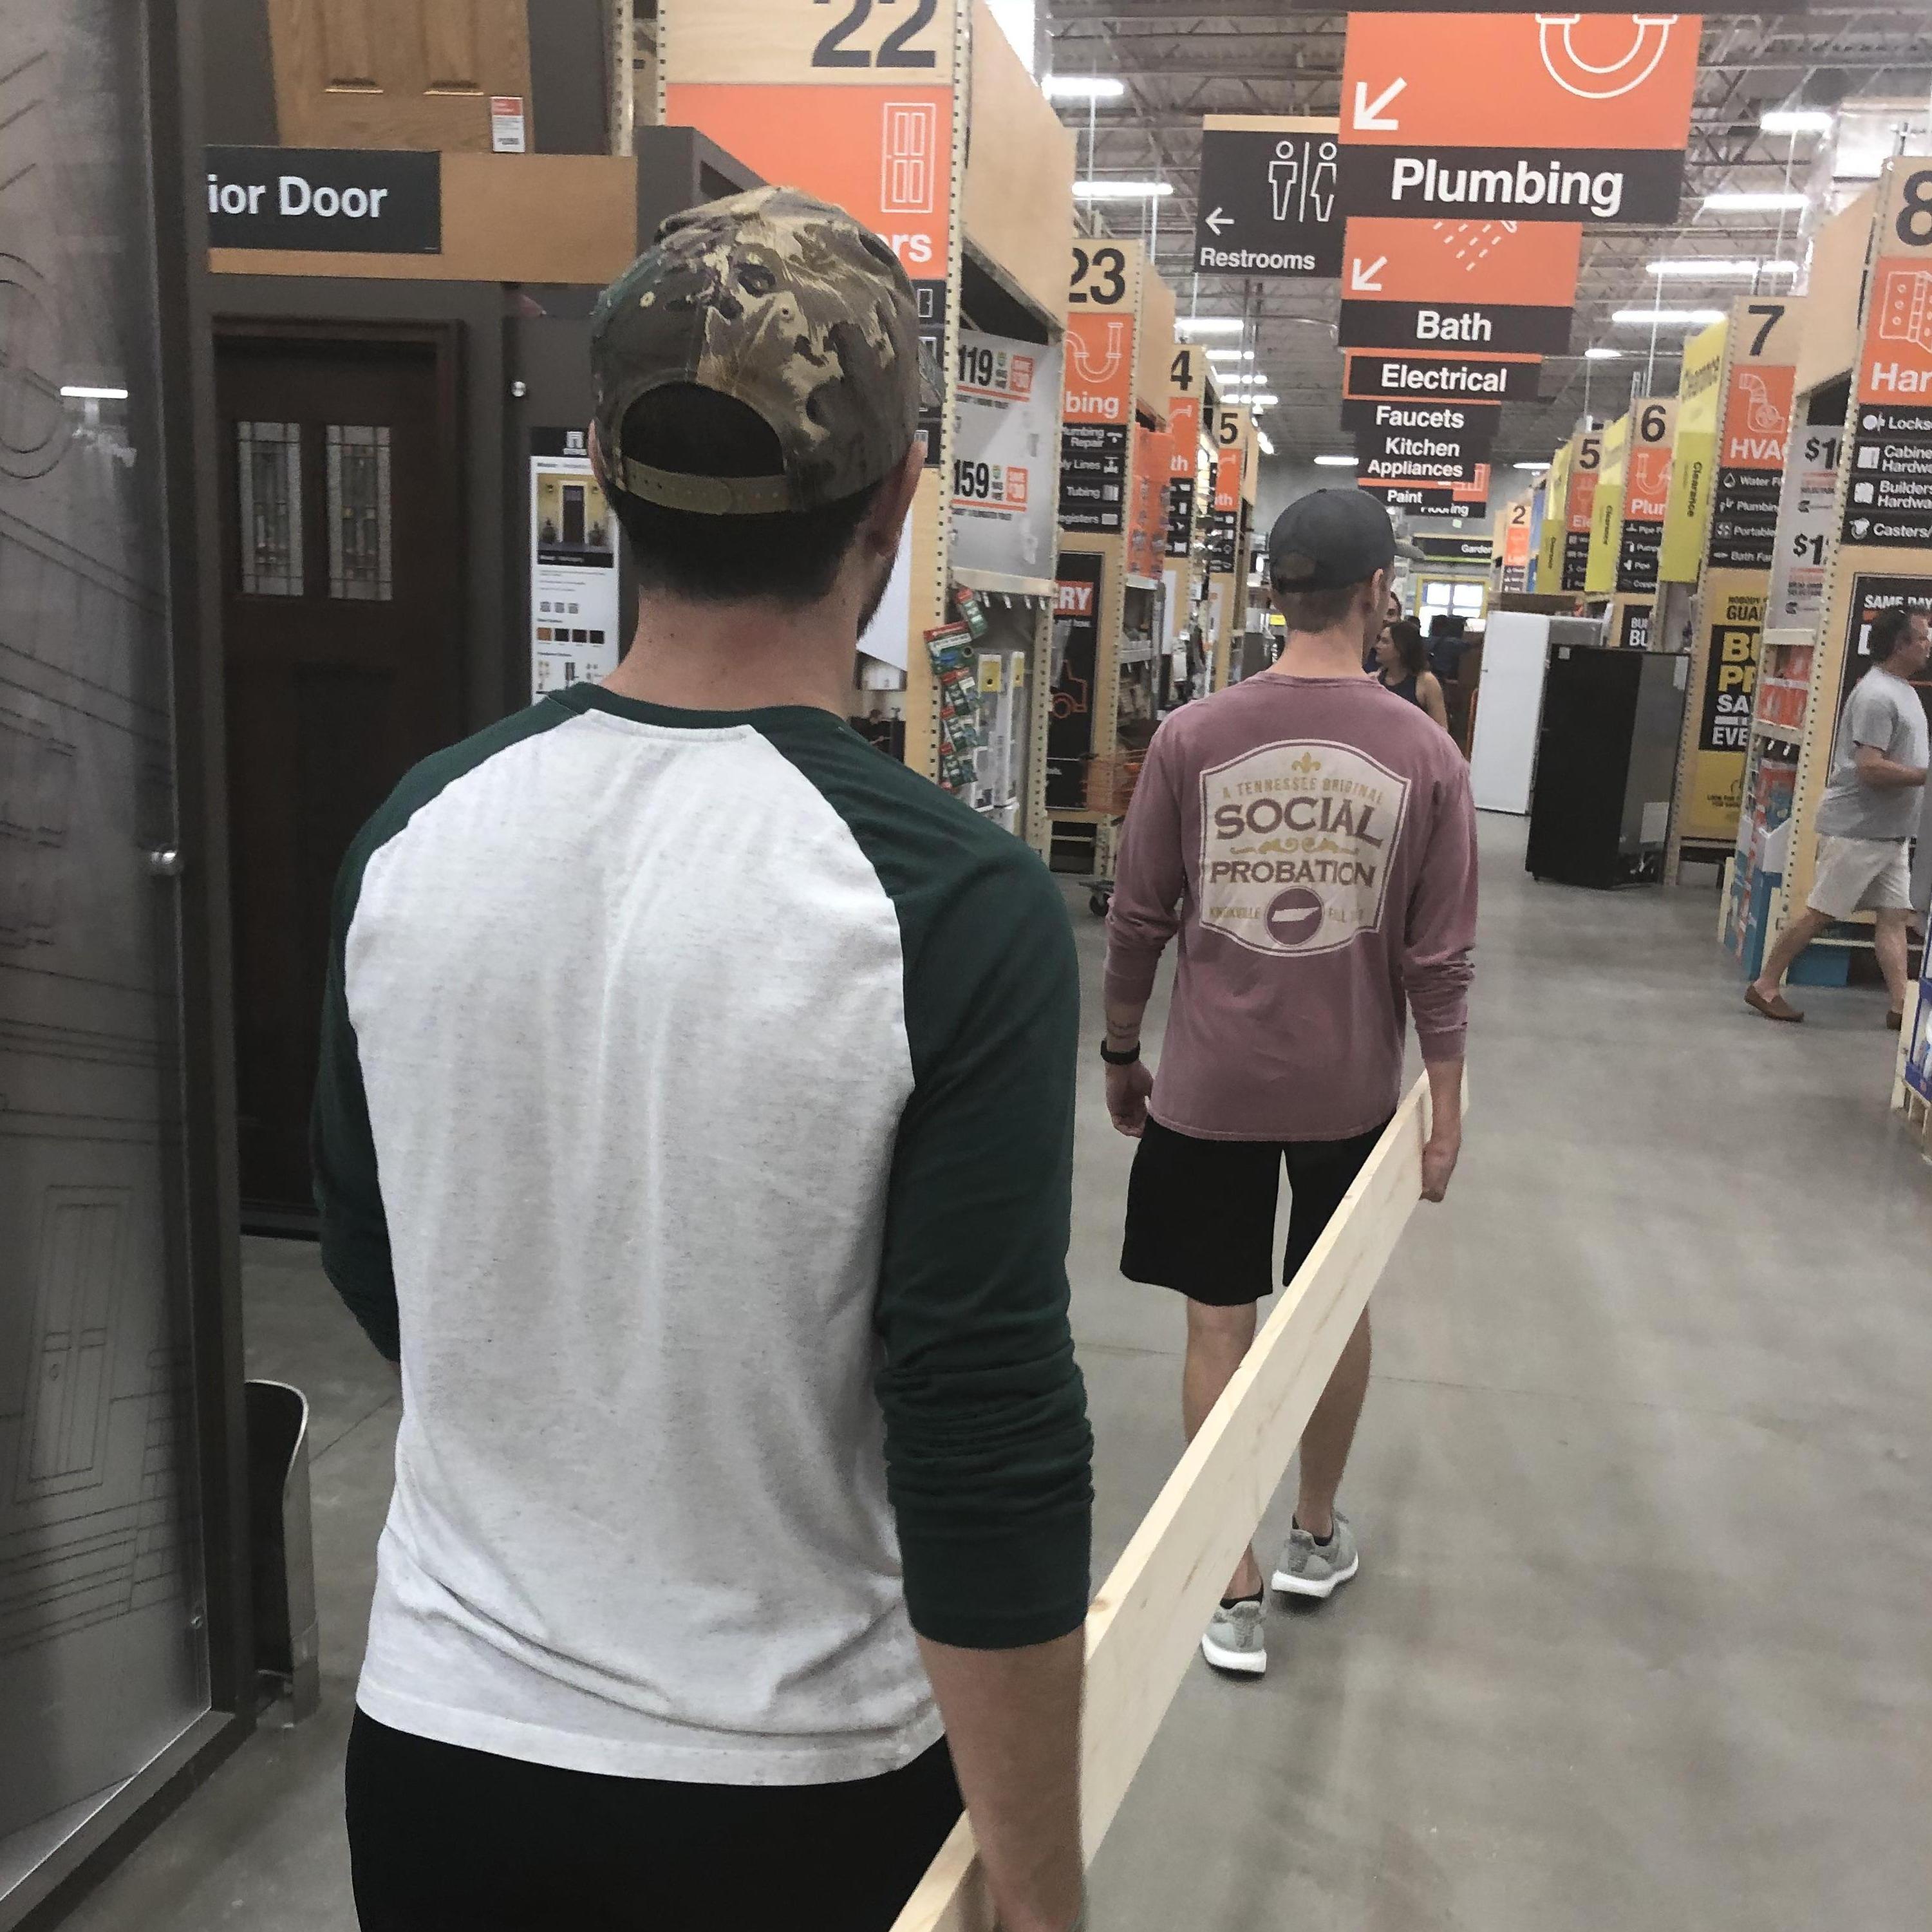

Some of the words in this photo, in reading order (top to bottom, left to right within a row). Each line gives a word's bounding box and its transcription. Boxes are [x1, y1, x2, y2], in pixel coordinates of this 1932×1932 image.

[811, 0, 937, 68] 22
[279, 176, 388, 218] Door
[1391, 158, 1624, 216] Plumbing
[876, 233, 933, 263] rs
[1200, 247, 1315, 271] Restrooms
[1416, 310, 1492, 342] Bath
[1747, 305, 1785, 357] 7
[1170, 350, 1193, 391] 4
[1381, 363, 1508, 393] Electrical
[1065, 391, 1120, 419] bing
[1376, 405, 1465, 429] Faucets
[1220, 412, 1239, 444] 5
[1642, 404, 1666, 442] 6
[1385, 436, 1460, 457] Kitchen
[1579, 438, 1600, 469] 5
[1367, 458, 1463, 479] Appliances
[1740, 476, 1770, 487] Water
[1387, 489, 1423, 503] Paint
[1687, 462, 1703, 517] Clearance
[1512, 505, 1526, 525] 2
[1060, 586, 1092, 610] RY
[1864, 594, 1904, 608] SAME
[1236, 777, 1317, 797] TENNESSEE
[1322, 777, 1383, 804] ORIGINAL
[1214, 796, 1383, 849] SOCIAL
[1209, 859, 1376, 888] PROBATION
